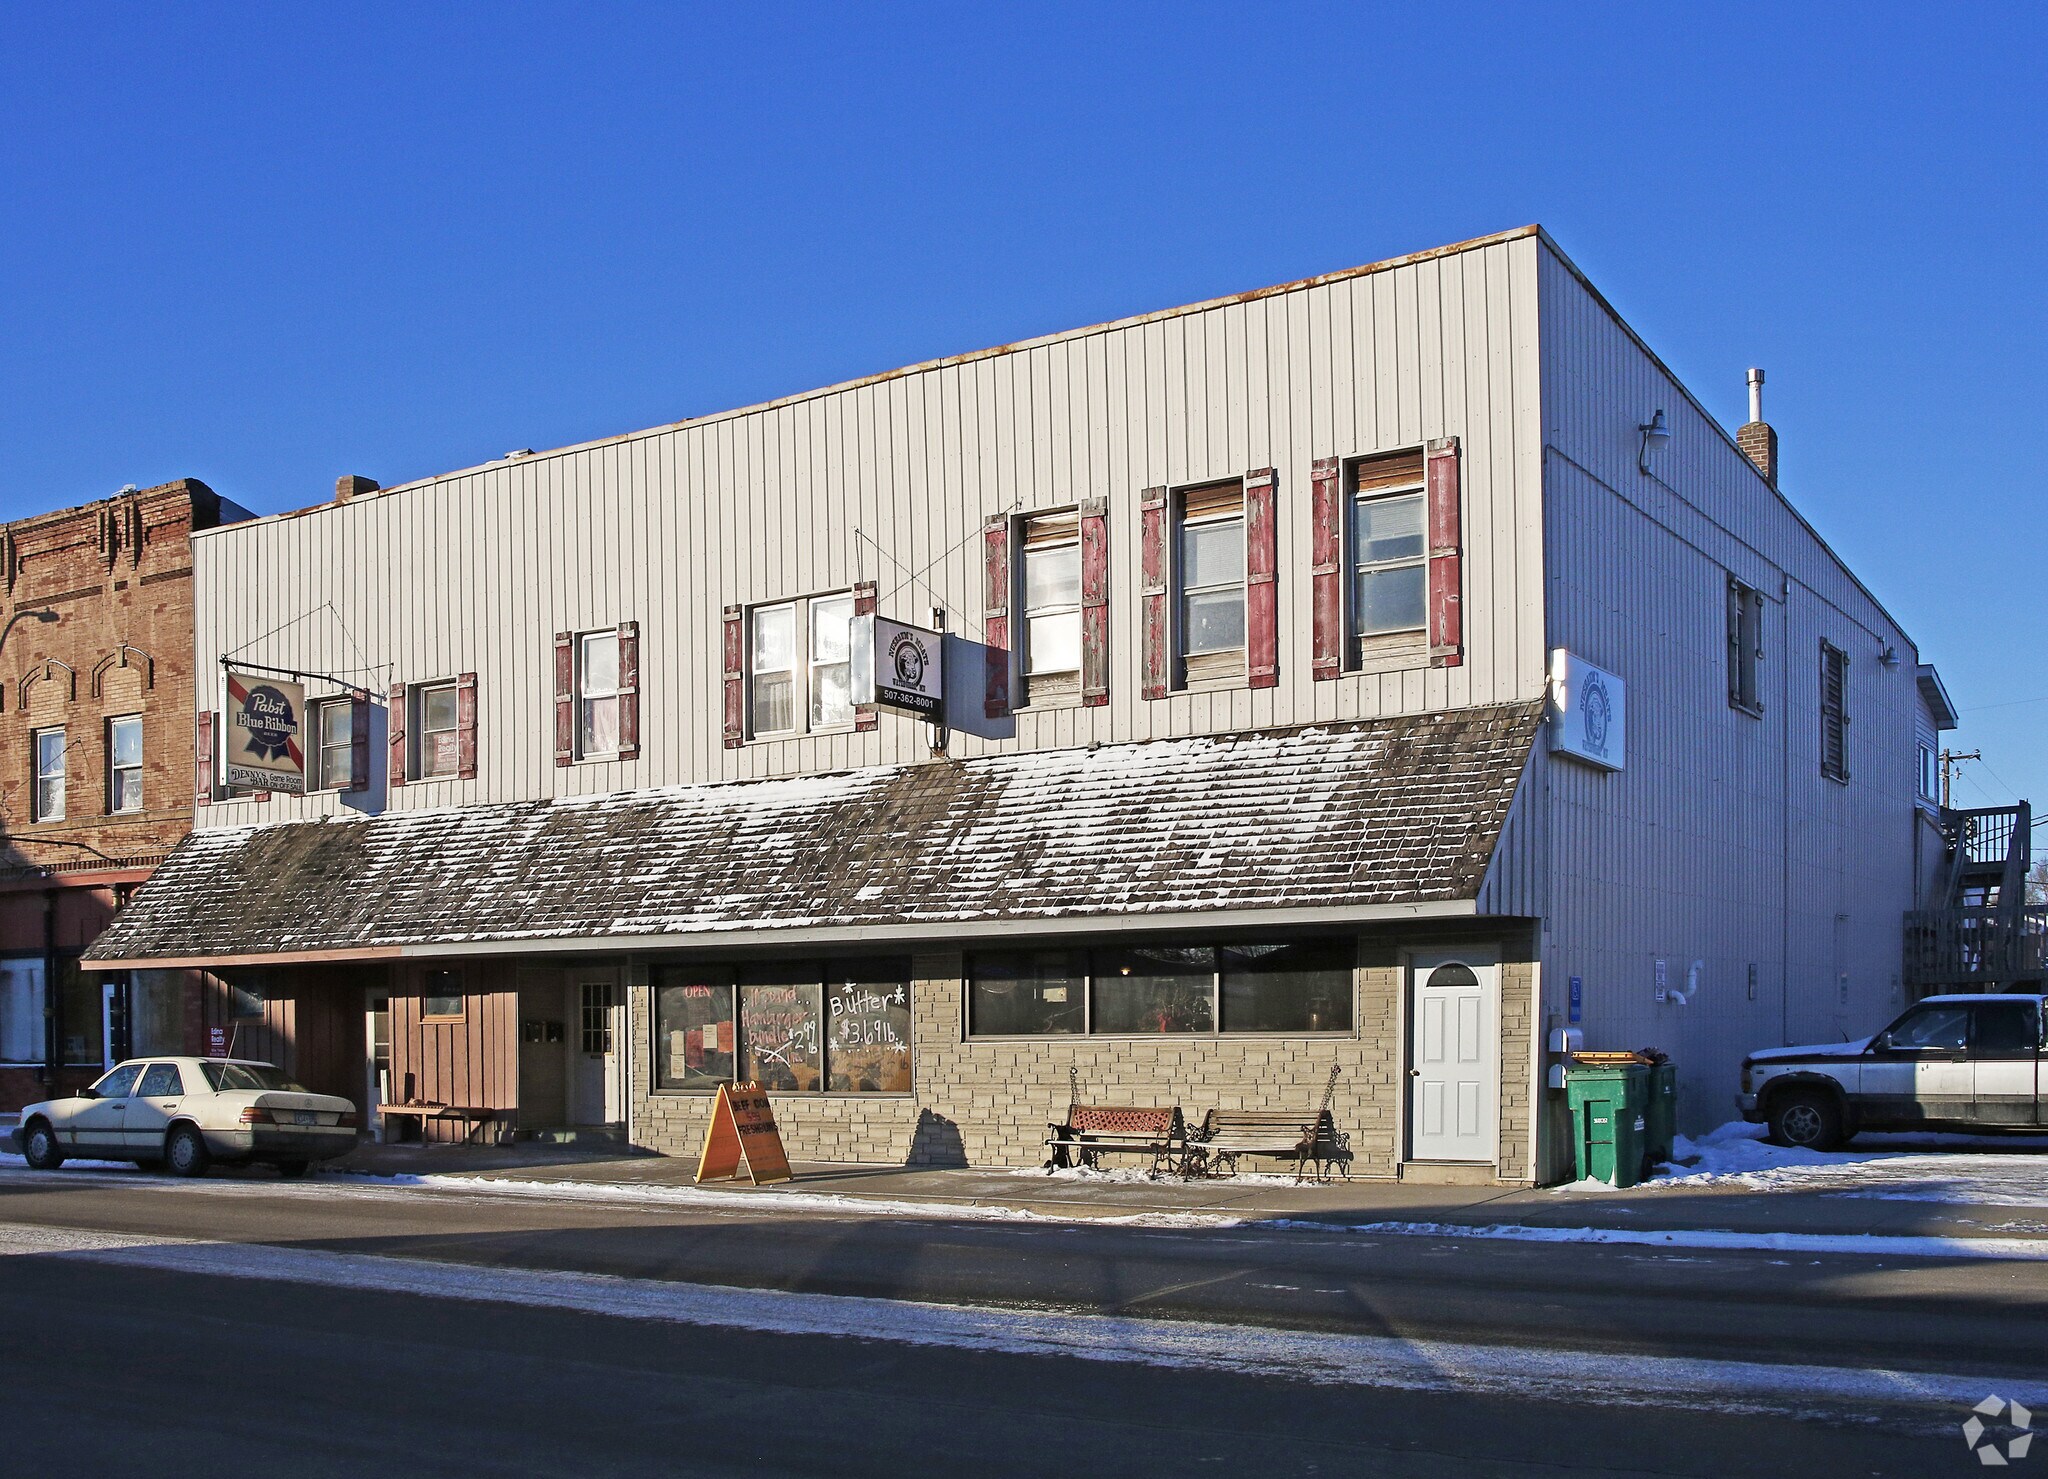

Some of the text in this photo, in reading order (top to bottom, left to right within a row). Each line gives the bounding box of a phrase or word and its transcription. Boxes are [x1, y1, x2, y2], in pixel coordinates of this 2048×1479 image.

[915, 637, 929, 666] MEATS
[252, 693, 286, 715] Pabst
[884, 690, 934, 708] 507-362-8001
[238, 712, 297, 734] Blue Ribbon
[250, 778, 269, 787] BAR
[684, 985, 712, 998] OPEN
[829, 989, 893, 1017] Butter
[741, 1009, 809, 1030] Hamburger
[748, 1026, 789, 1046] bundle
[732, 1099, 749, 1111] BEEF
